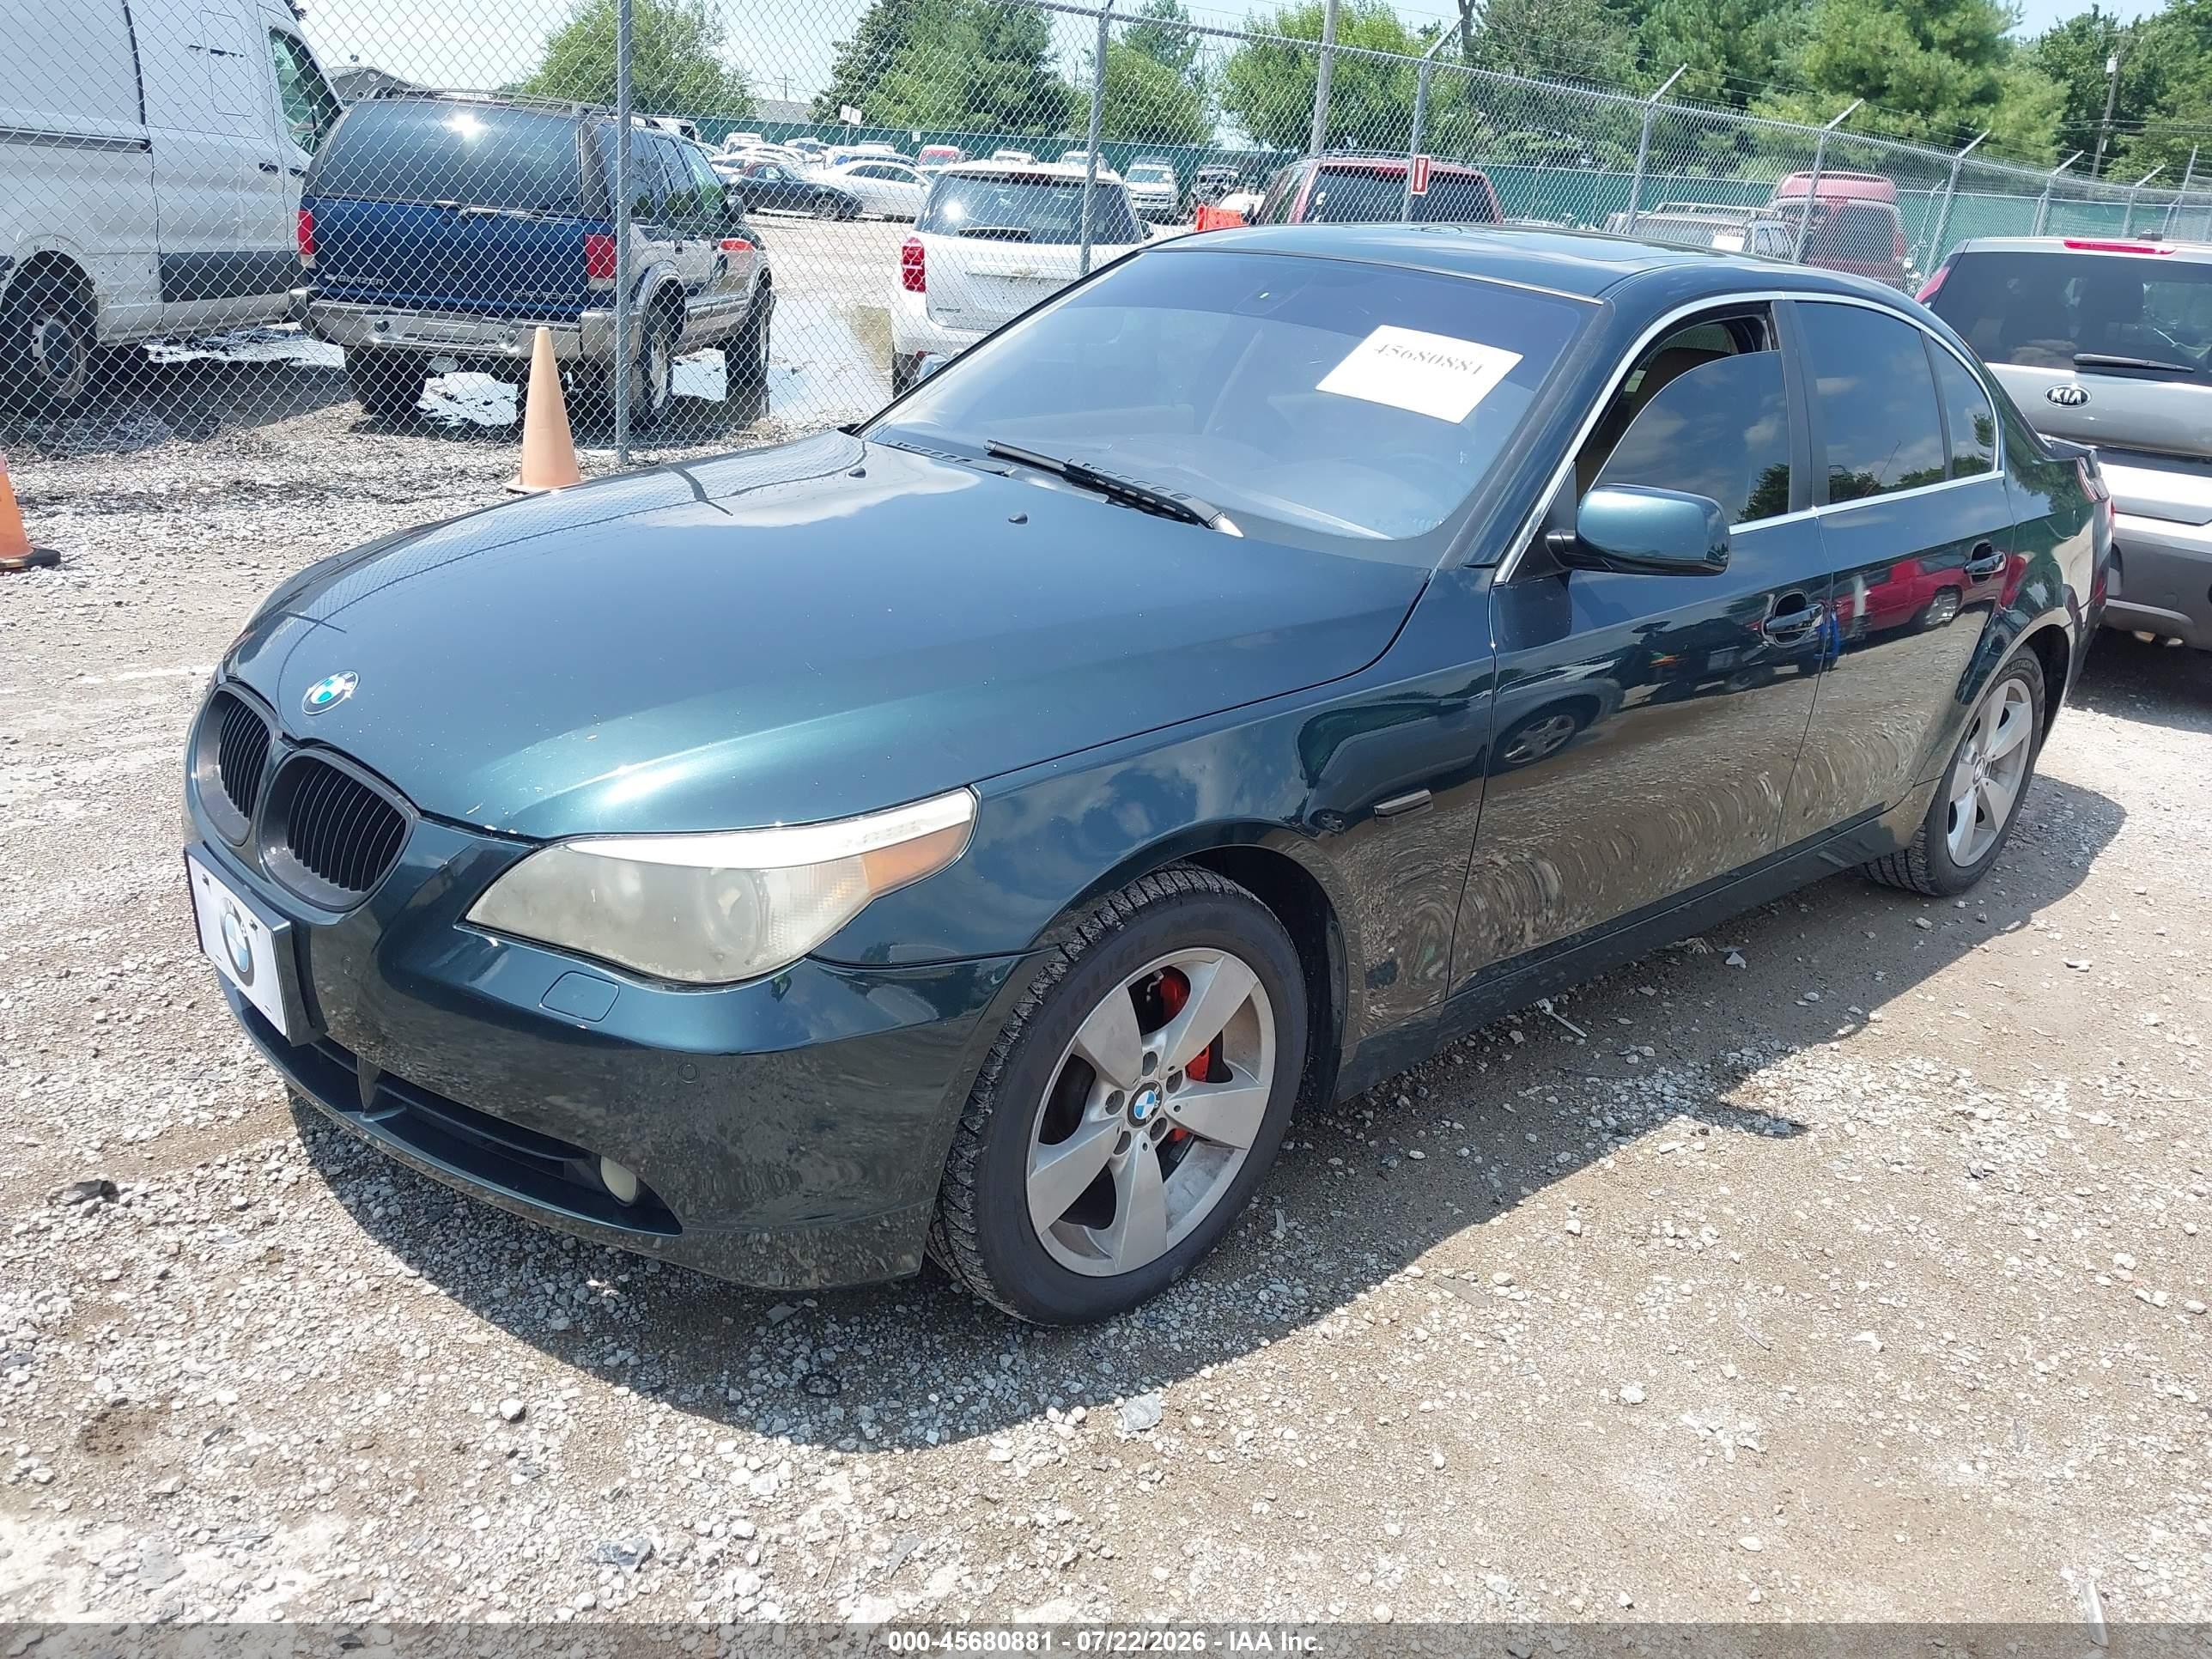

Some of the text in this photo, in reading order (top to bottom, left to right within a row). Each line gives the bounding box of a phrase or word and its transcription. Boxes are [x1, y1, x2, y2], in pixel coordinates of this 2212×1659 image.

[337, 275, 385, 286] BLAZER
[1375, 343, 1483, 374] 45680881
[2050, 388, 2082, 404] KIA
